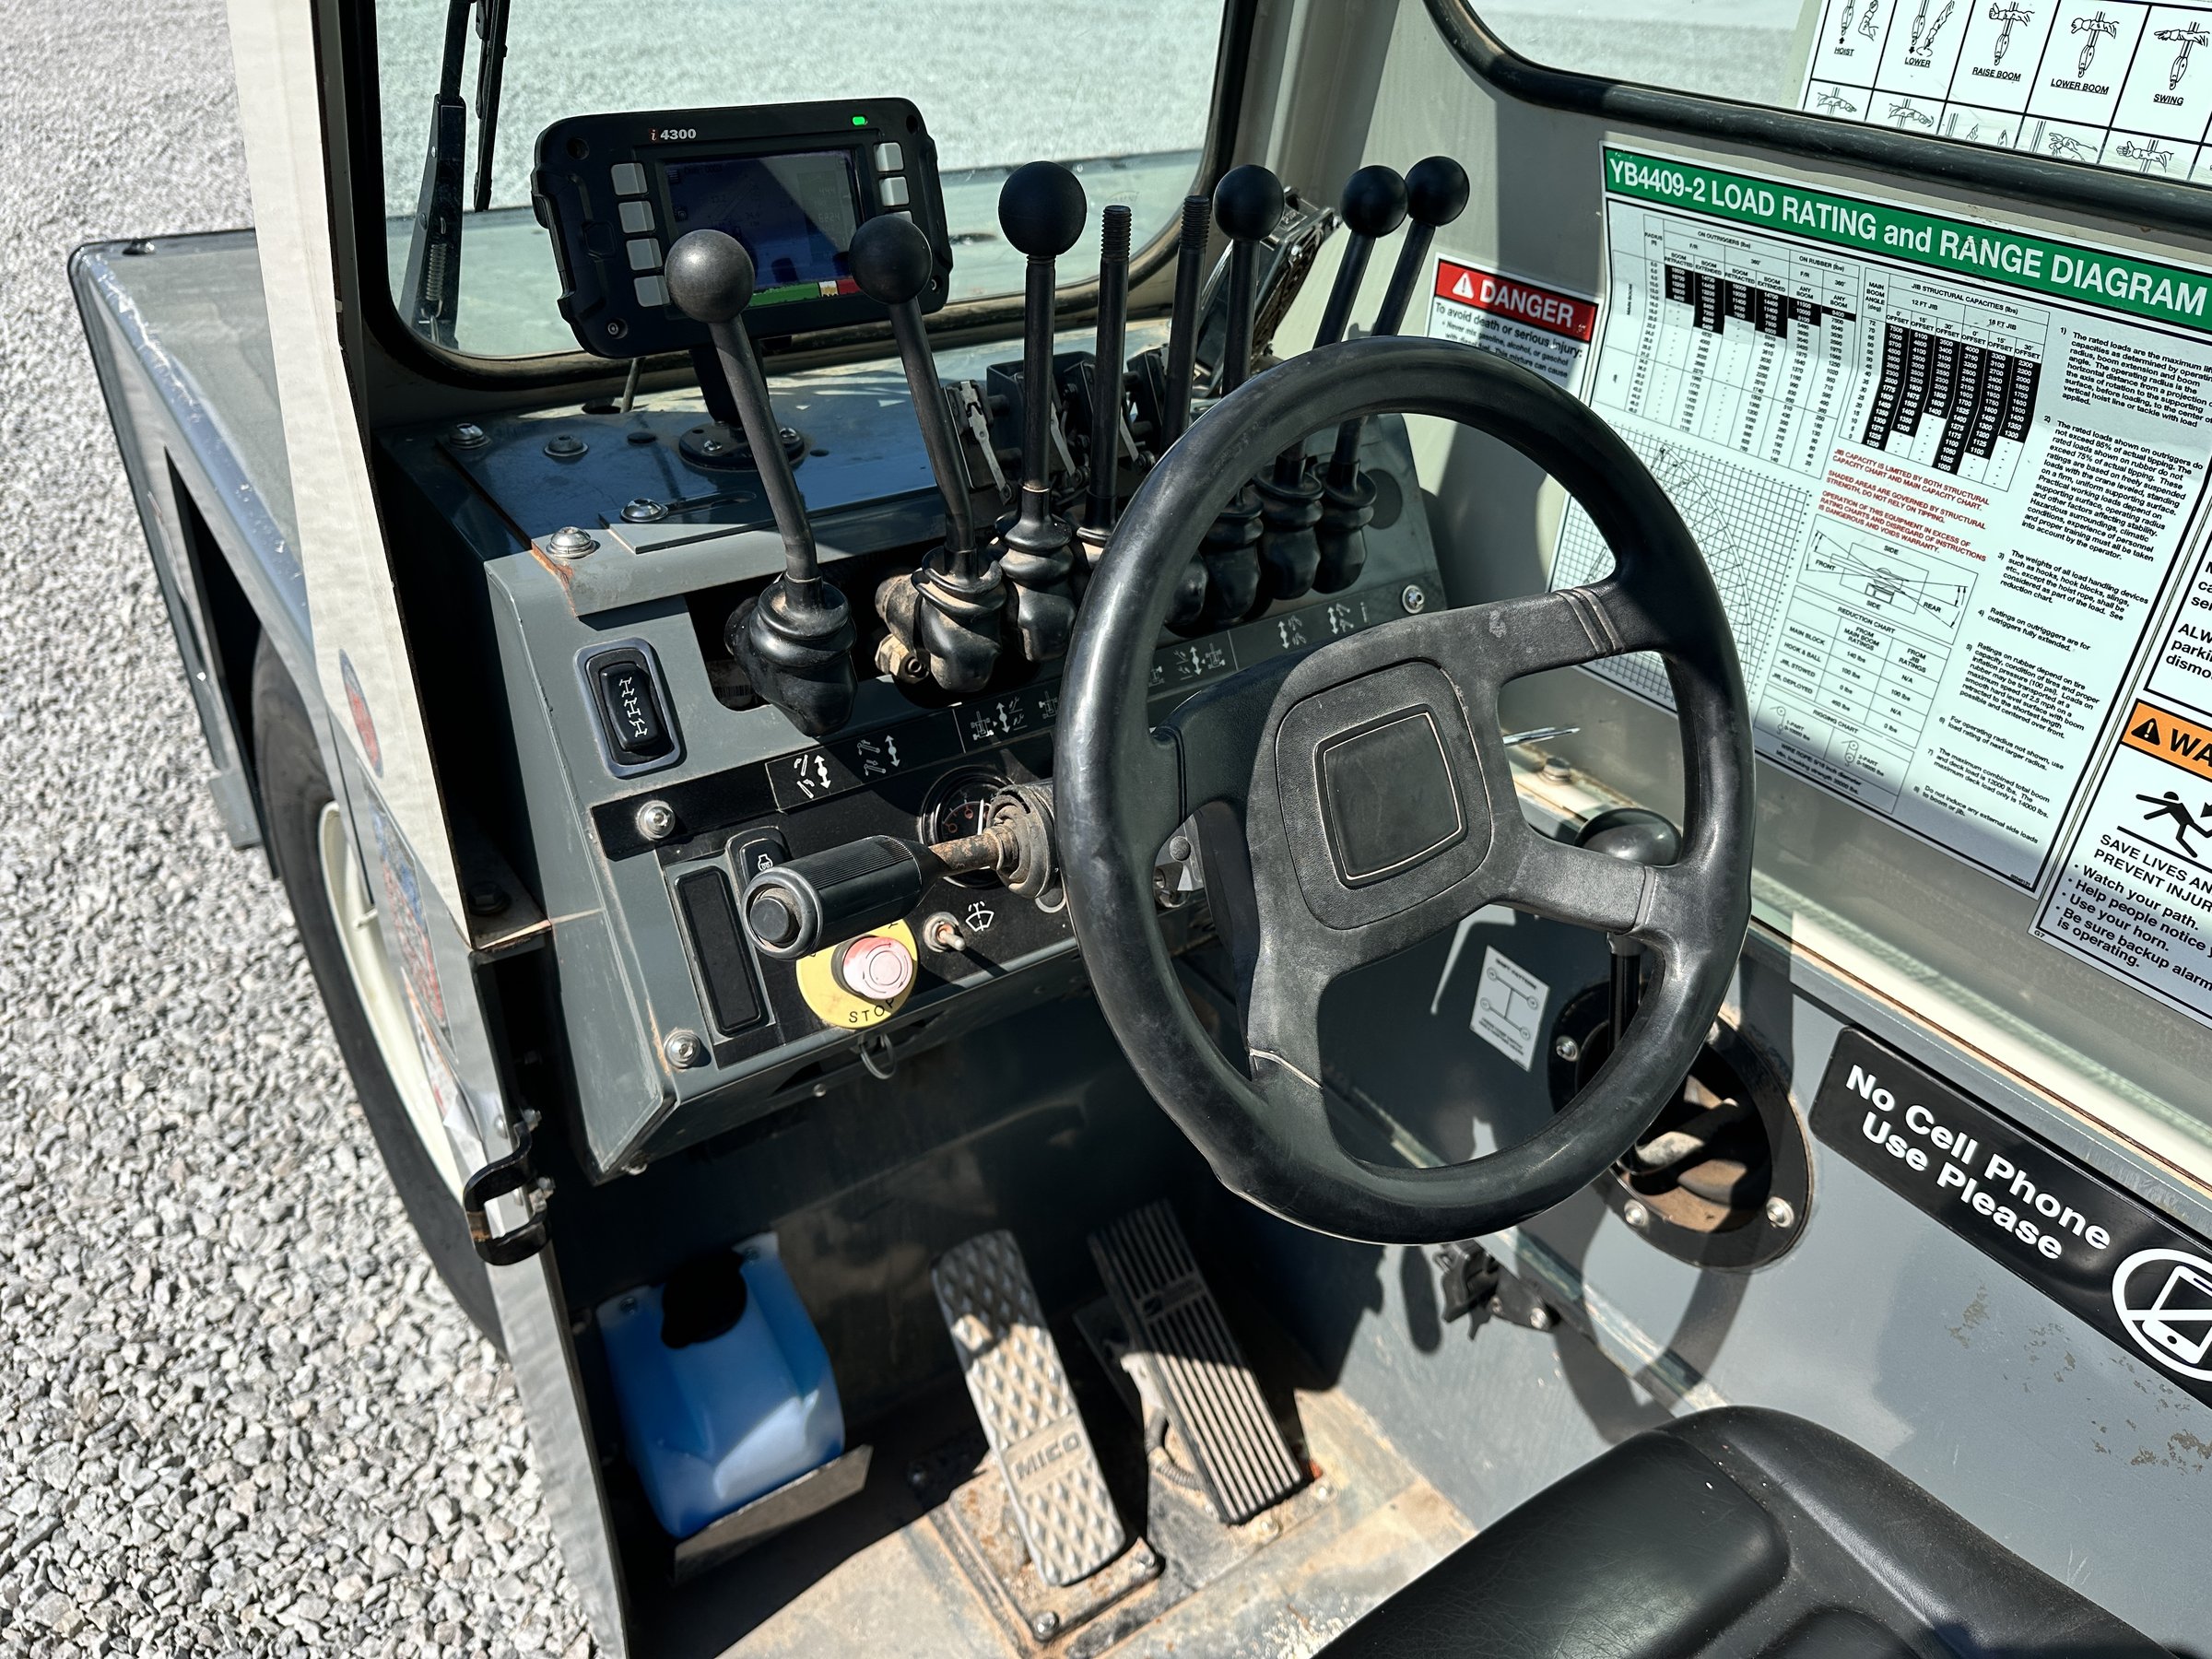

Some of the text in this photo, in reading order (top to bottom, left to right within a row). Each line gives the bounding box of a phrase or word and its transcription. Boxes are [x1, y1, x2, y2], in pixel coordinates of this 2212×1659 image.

[1834, 46, 1853, 55] HOIST
[1904, 55, 1931, 66] LOWER
[1971, 66, 2021, 80] RAISE BOOM
[2050, 79, 2109, 92] LOWER BOOM
[2153, 95, 2183, 105] SWING
[660, 128, 697, 140] 4300
[1609, 158, 2209, 316] YB4409-2 LOAD RATING and RANGE DIAGRAM
[1479, 279, 1573, 327] DANGER
[1922, 285, 1964, 300] STRUCTURAL
[1965, 296, 2004, 310] CAPACITIES
[2005, 305, 2018, 314] (lbs)
[1435, 302, 1583, 359] To avoid death or serious injury:
[1477, 332, 1504, 347] gasoline,
[1506, 340, 1531, 355] alcohol,
[2073, 331, 2087, 340] The
[2088, 336, 2109, 346] rated
[2110, 340, 2131, 351] loads
[2147, 350, 2160, 359] the
[2161, 355, 2202, 370] maximum
[2068, 355, 2093, 366] angle.
[2094, 360, 2109, 371] The
[2111, 366, 2147, 382] operating
[2148, 376, 2173, 387] radius
[2183, 384, 2197, 394] the
[2070, 347, 2200, 386] radius, boom extension and boom
[2071, 340, 2110, 354] capacities
[2122, 352, 2167, 370] determined
[2062, 392, 2090, 405] applied.
[2065, 369, 2077, 378] the
[2079, 373, 2094, 382] axis
[2105, 381, 2135, 394] rotation
[2146, 391, 2159, 400] the
[2160, 396, 2204, 414] supporting
[2065, 378, 2093, 391] surface,
[2095, 384, 2120, 397] before
[2121, 392, 2151, 407] loading,
[2163, 404, 2176, 413] the
[2177, 409, 2204, 420] center
[2067, 361, 2104, 377] horizontal
[2105, 371, 2138, 386] distance
[2139, 381, 2159, 392] from
[2166, 389, 2206, 405] projection
[2064, 385, 2090, 396] vertical
[2091, 391, 2111, 402] hoist
[2112, 397, 2125, 406] line
[2136, 404, 2159, 417] tackle
[2161, 412, 2179, 421] with
[2180, 416, 2197, 427] load
[1832, 454, 1981, 510] CAPACITY CHART AND MAIN CAPACITY CHART.
[1844, 451, 1877, 465] CAPACITY
[1885, 464, 1912, 477] LIMITED
[1923, 477, 1942, 488] BOTH
[1943, 484, 1990, 504] STRUCTURAL
[1987, 615, 2070, 651] outriggers fully extended.
[1990, 606, 2015, 621] Ratings
[2066, 637, 2078, 645] are
[2079, 641, 2090, 650] for
[2094, 849, 2165, 888] PREVENT
[2100, 834, 2140, 859] SAVE
[2143, 853, 2187, 881] LIVES
[2076, 879, 2206, 951] Help people notice
[2083, 865, 2198, 930] Watch your path.
[2033, 929, 2045, 939] G7
[2057, 917, 2140, 967] is operating.
[2064, 908, 2082, 923] Be
[2084, 920, 2115, 940] sure
[2118, 935, 2170, 969] backup
[2069, 894, 2169, 951] Use your horn.
[849, 998, 894, 1023] STOP
[1846, 1065, 2111, 1251] No Cell Phone
[1862, 1112, 2063, 1260] Use Please
[1015, 1430, 1082, 1480] MICO
